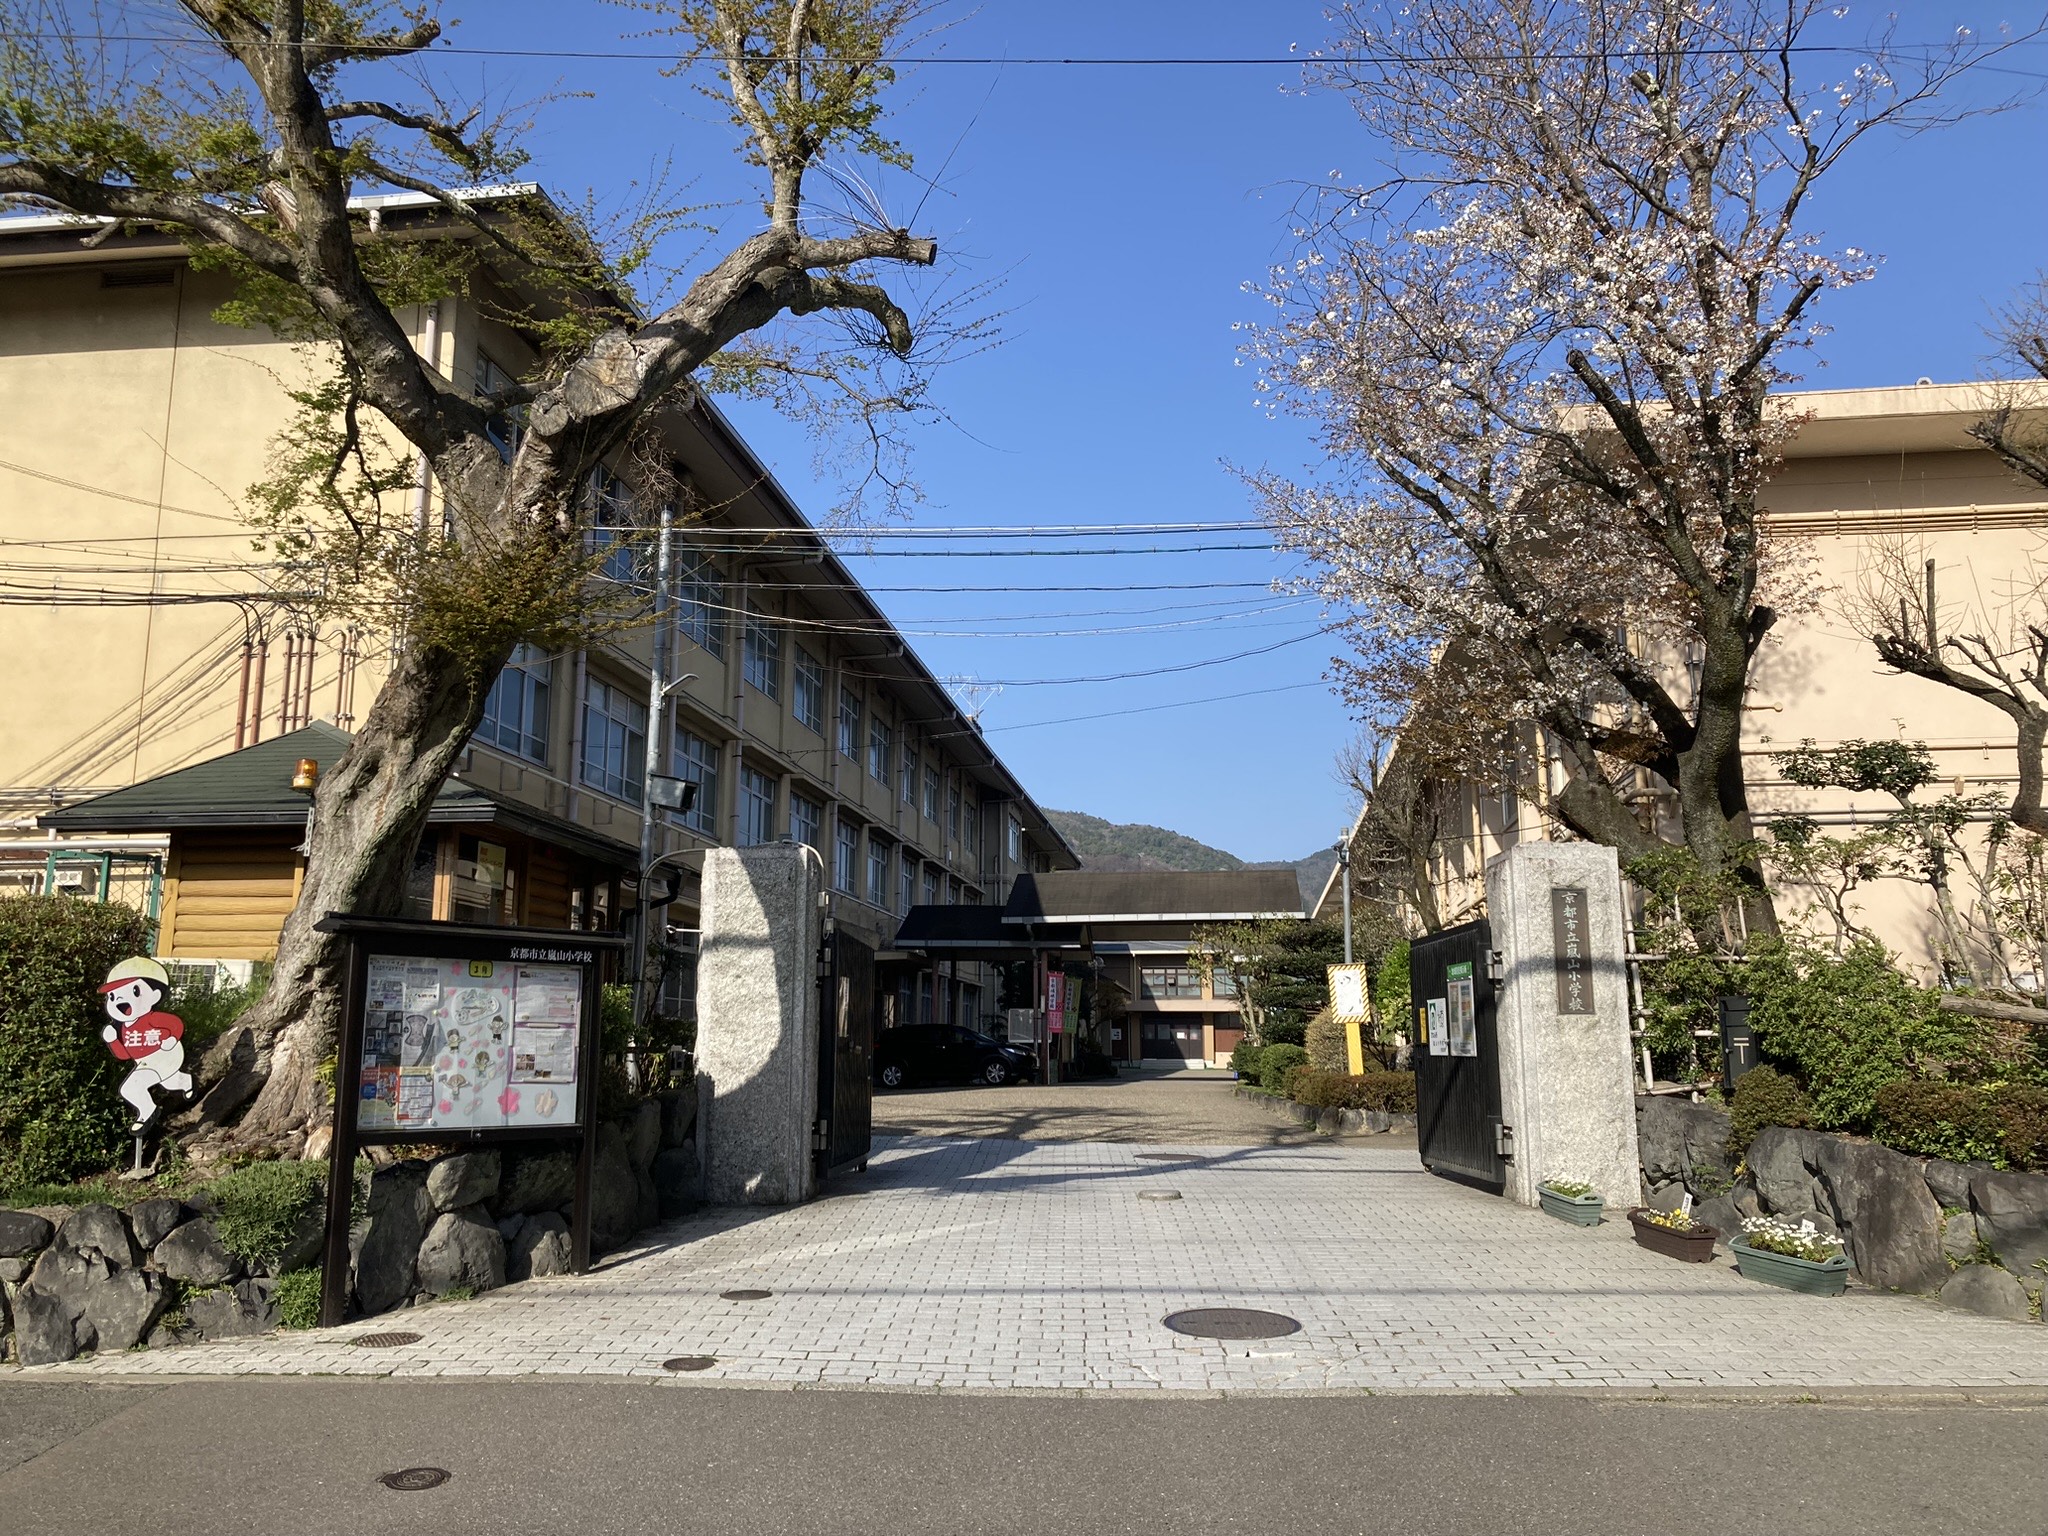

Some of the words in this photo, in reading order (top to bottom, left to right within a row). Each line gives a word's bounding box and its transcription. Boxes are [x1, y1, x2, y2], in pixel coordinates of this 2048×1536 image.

[510, 947, 593, 963] 京都市立嵐山小学校
[1562, 892, 1585, 1011] 京都市立嵐山小学校
[124, 1028, 162, 1047] 注意
